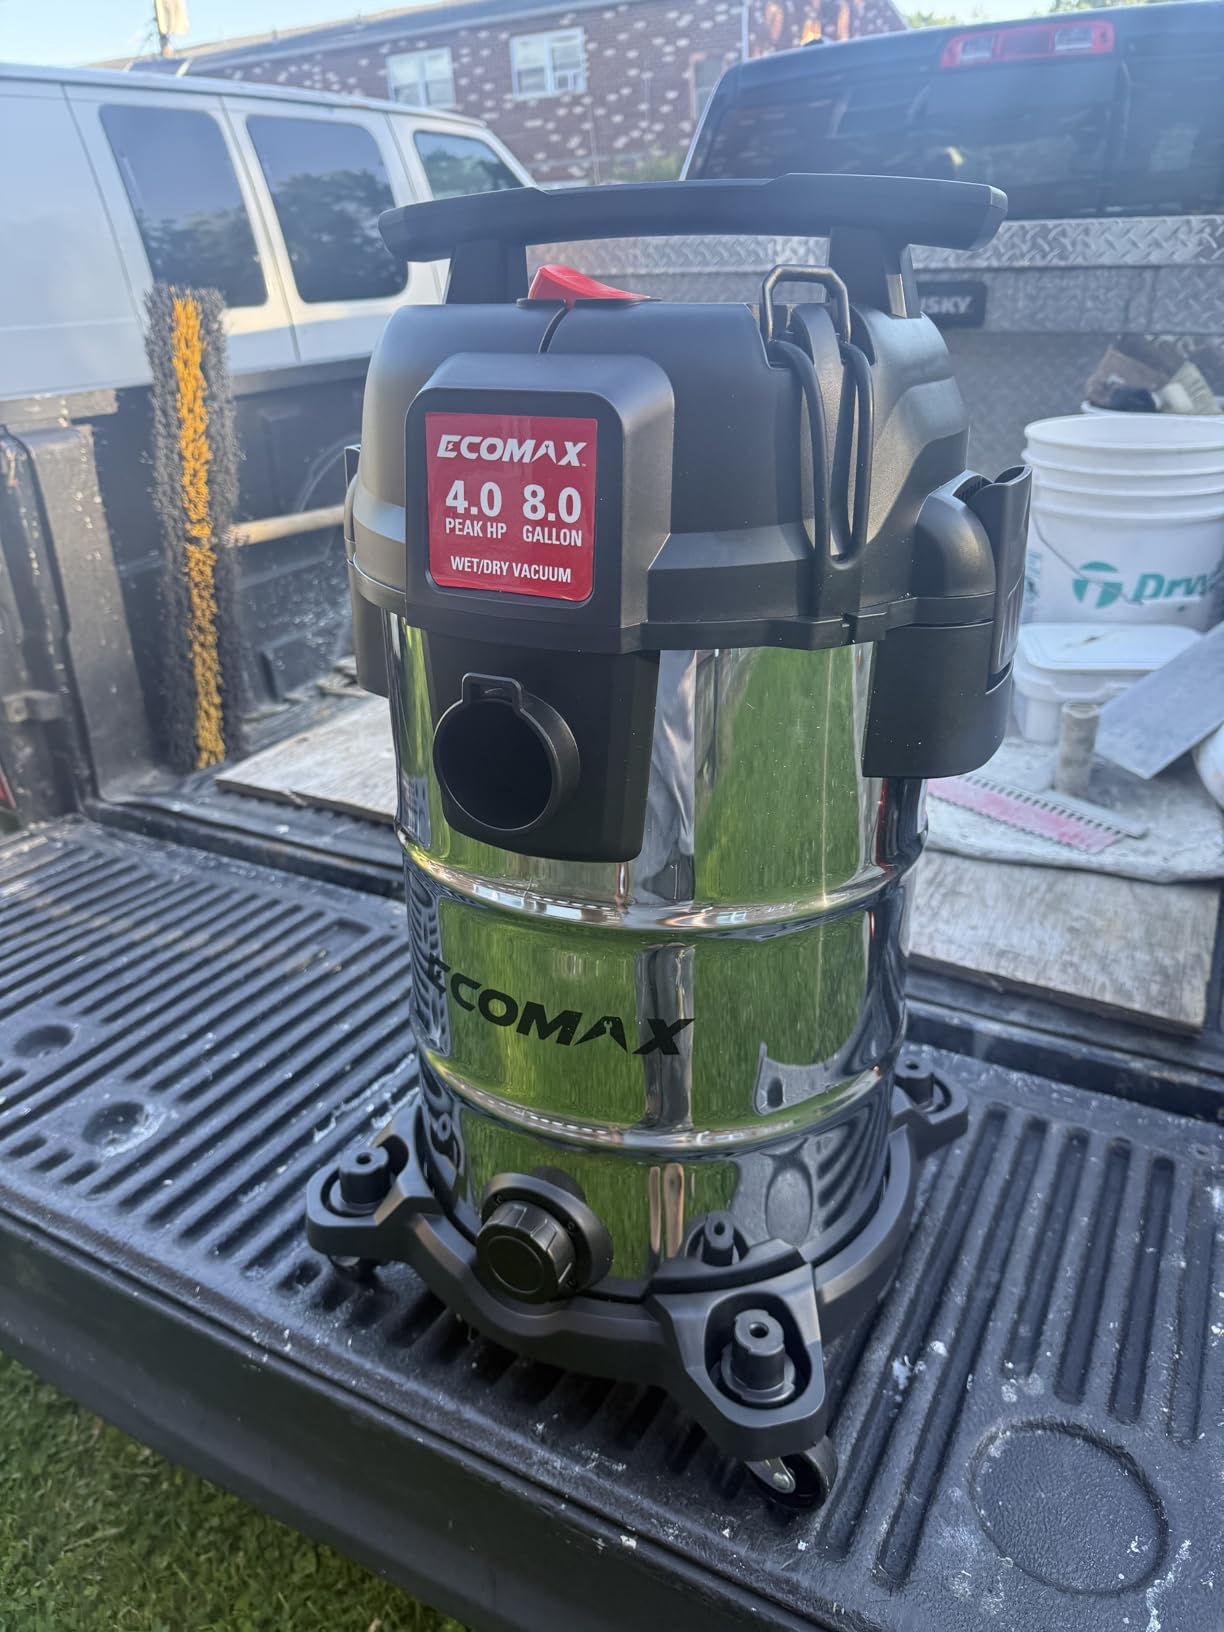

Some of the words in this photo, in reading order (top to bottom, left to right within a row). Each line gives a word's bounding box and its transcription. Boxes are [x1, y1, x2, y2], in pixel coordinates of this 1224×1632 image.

[436, 434, 588, 467] ECOMAX
[445, 479, 503, 517] 4.0
[522, 484, 582, 524] 8.0
[445, 518, 483, 537] PEAK
[487, 522, 507, 539] HP
[522, 525, 583, 547] GALLON
[450, 555, 510, 576] WET/DRY
[512, 563, 572, 583] VACUUM
[426, 951, 696, 1056] ECOMAX
